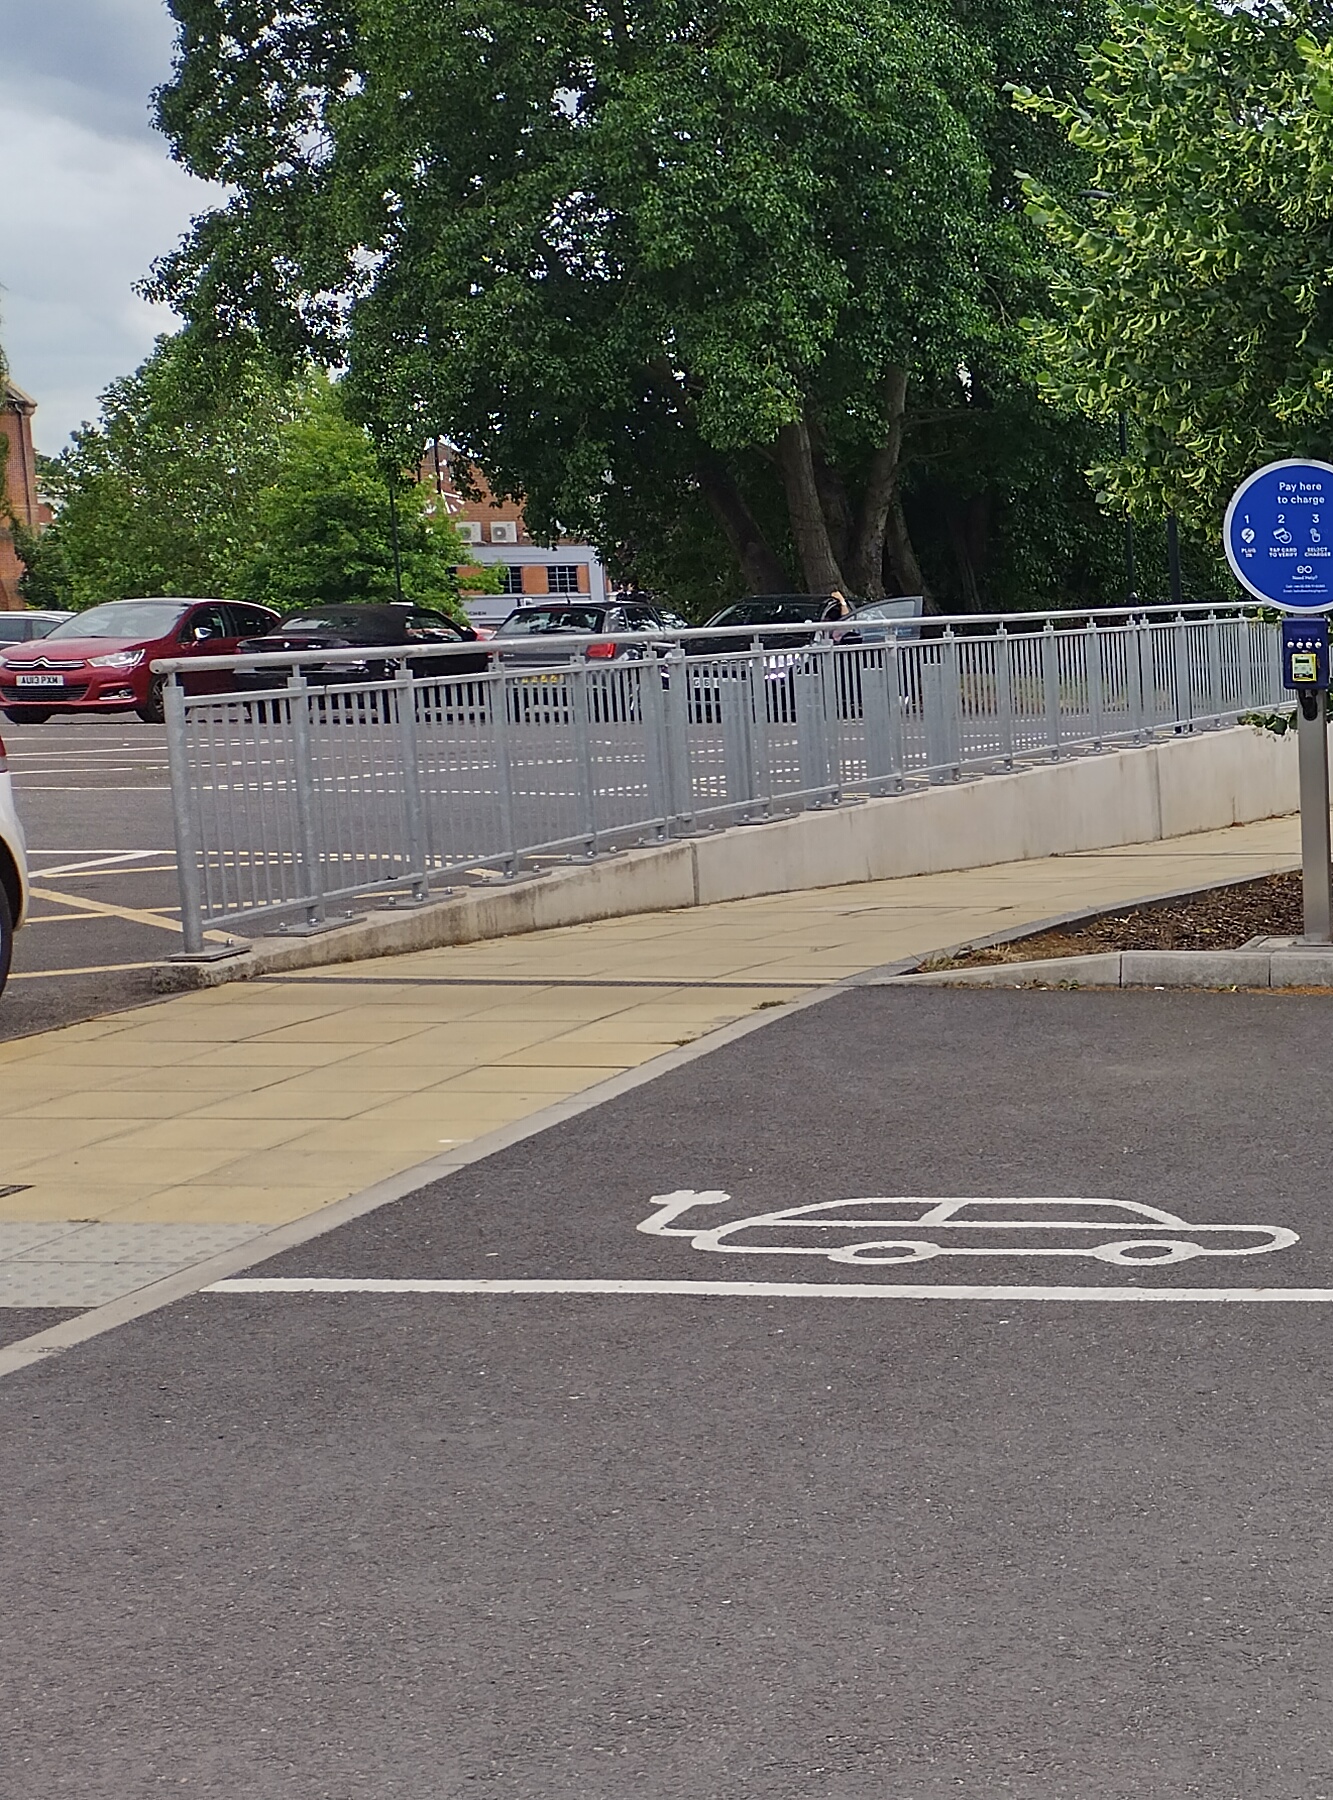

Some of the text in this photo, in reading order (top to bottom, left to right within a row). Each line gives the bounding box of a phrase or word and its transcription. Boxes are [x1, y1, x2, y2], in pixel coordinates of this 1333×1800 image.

[1279, 481, 1322, 493] Pay here
[1277, 495, 1325, 506] to charge
[1244, 514, 1250, 524] 1
[1277, 514, 1285, 524] 2
[1312, 513, 1320, 524] 3
